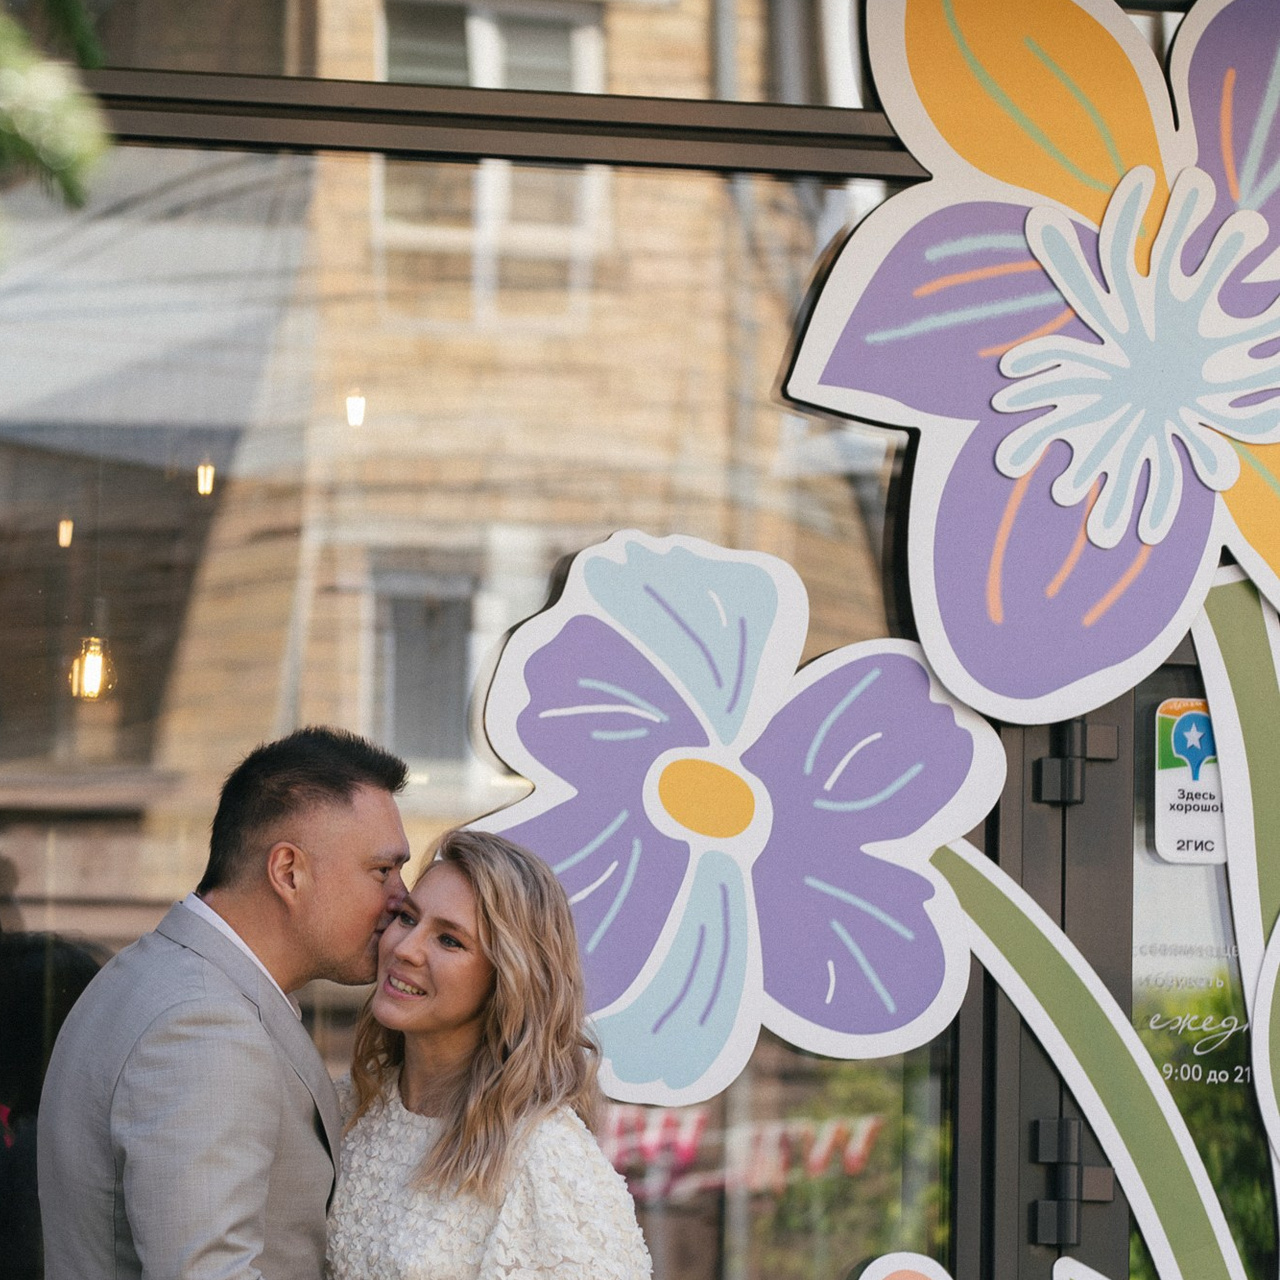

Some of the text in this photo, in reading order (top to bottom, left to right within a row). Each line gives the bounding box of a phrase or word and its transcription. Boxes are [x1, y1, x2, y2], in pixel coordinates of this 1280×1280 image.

[1177, 788, 1216, 801] Здесь
[1169, 802, 1224, 814] хорошо!
[1176, 839, 1215, 852] 2ГИС
[1162, 1063, 1203, 1081] 9:00
[1206, 1070, 1229, 1084] до
